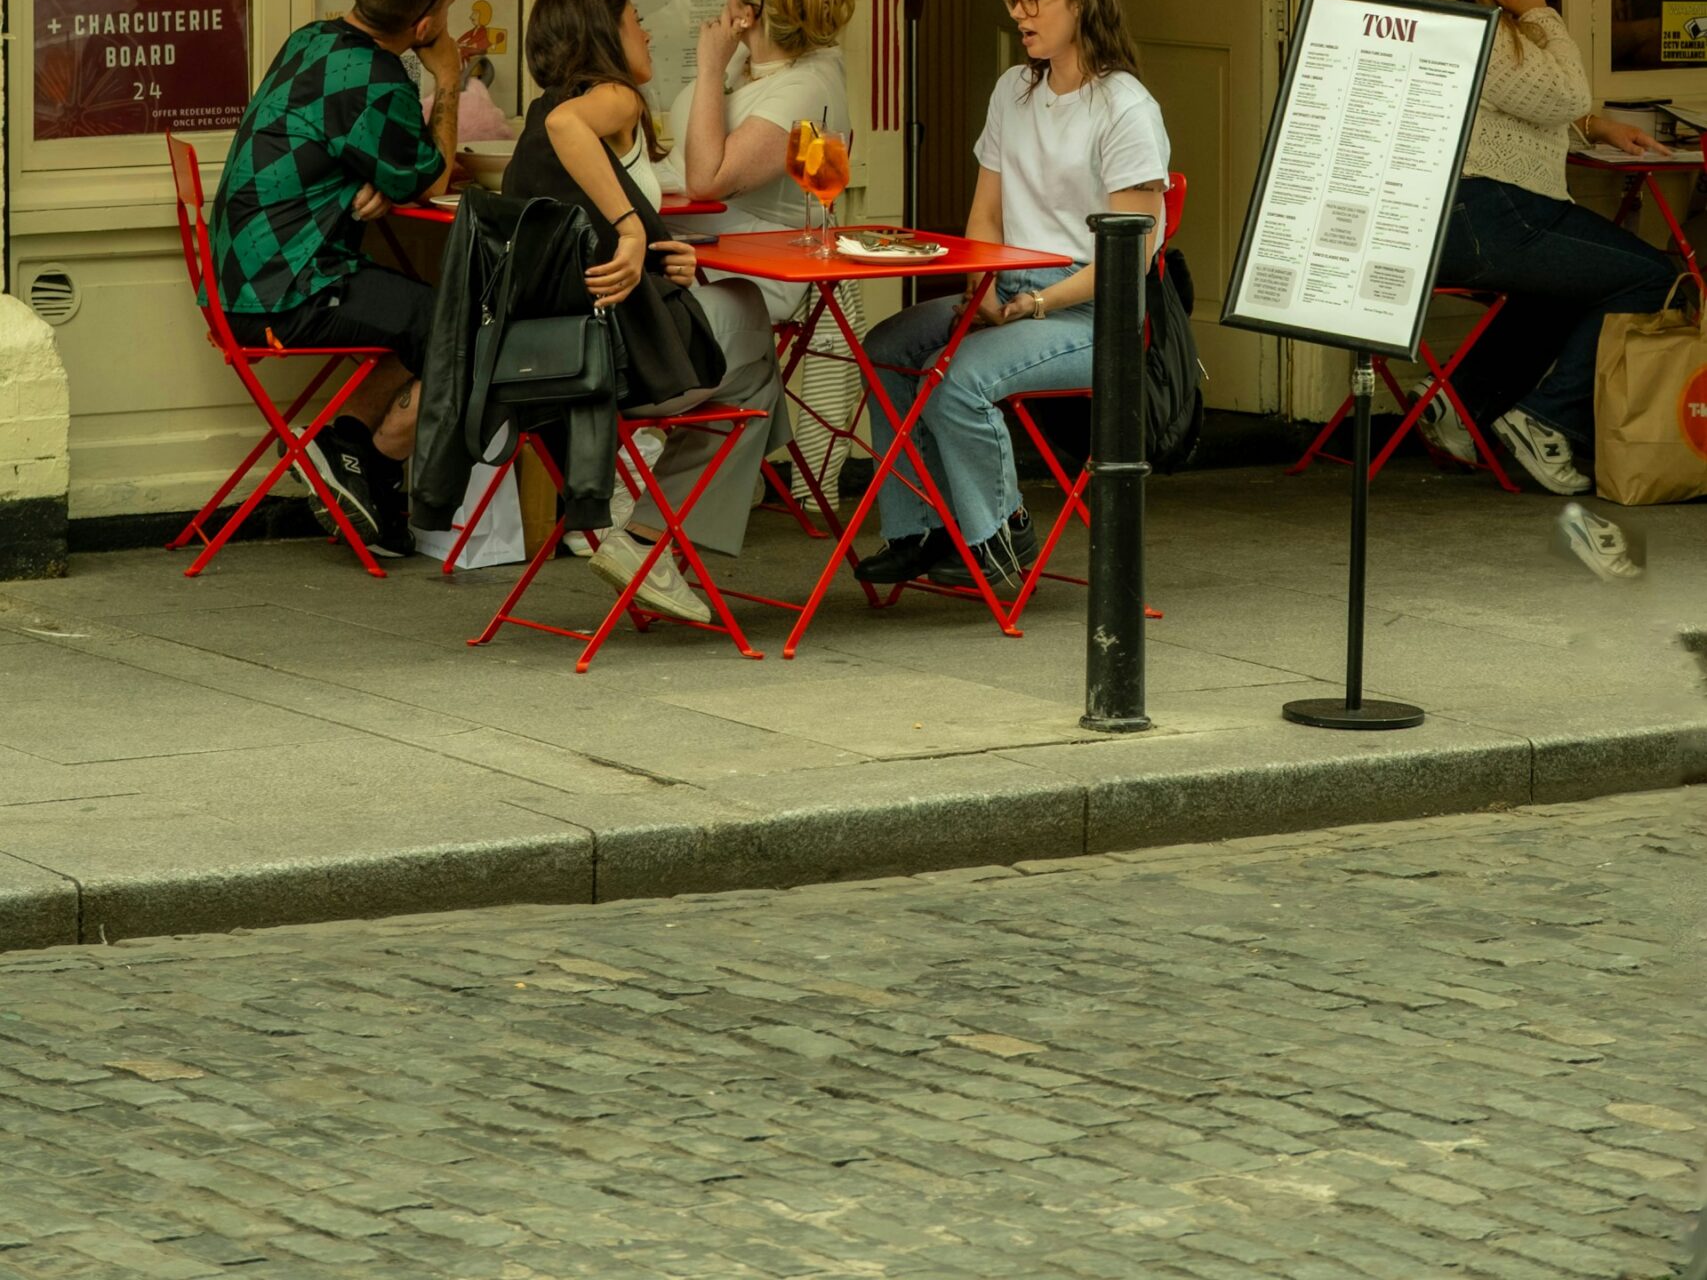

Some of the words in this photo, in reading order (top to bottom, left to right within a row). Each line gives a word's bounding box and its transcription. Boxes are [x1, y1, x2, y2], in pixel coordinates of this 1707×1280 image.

[75, 8, 223, 36] CHARCUTERIE
[1362, 13, 1418, 43] TONI
[1663, 41, 1679, 49] CCTV
[1680, 41, 1705, 49] CAMERA
[1663, 50, 1705, 59] SURVEILLANCE
[105, 43, 176, 68] BOARD
[133, 82, 162, 101] 24
[152, 108, 178, 118] OFFER
[180, 106, 222, 117] REDEEMED
[224, 105, 246, 115] ONLY
[173, 118, 195, 127] ONCE
[198, 117, 213, 126] PER
[340, 452, 362, 475] N
